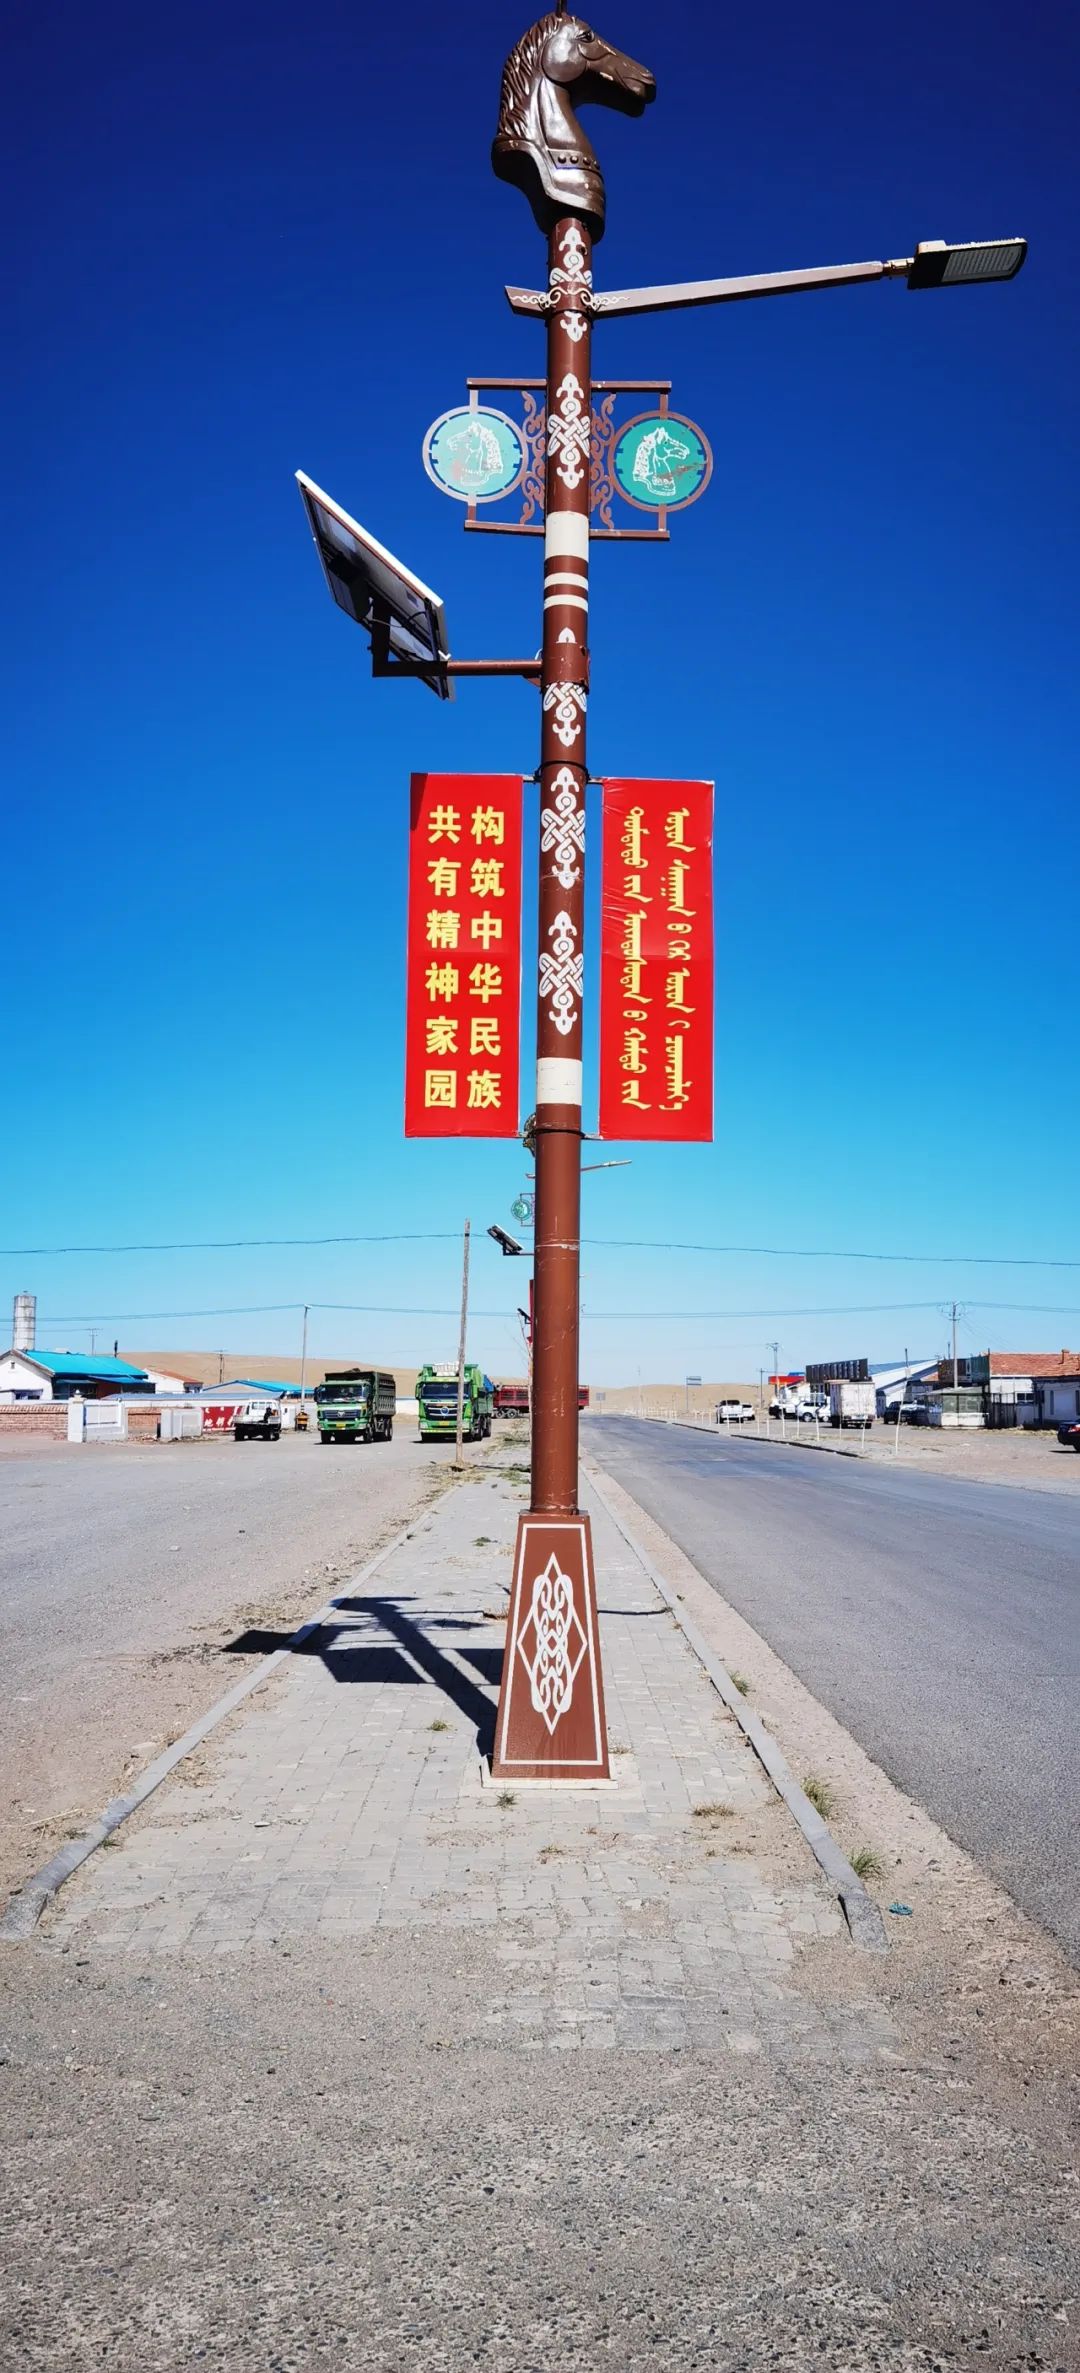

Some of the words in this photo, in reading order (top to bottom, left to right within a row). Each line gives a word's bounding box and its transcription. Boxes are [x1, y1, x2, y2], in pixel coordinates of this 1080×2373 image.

[424, 804, 462, 1109] 共有精神家园
[466, 805, 505, 1109] 构筑中华民族
